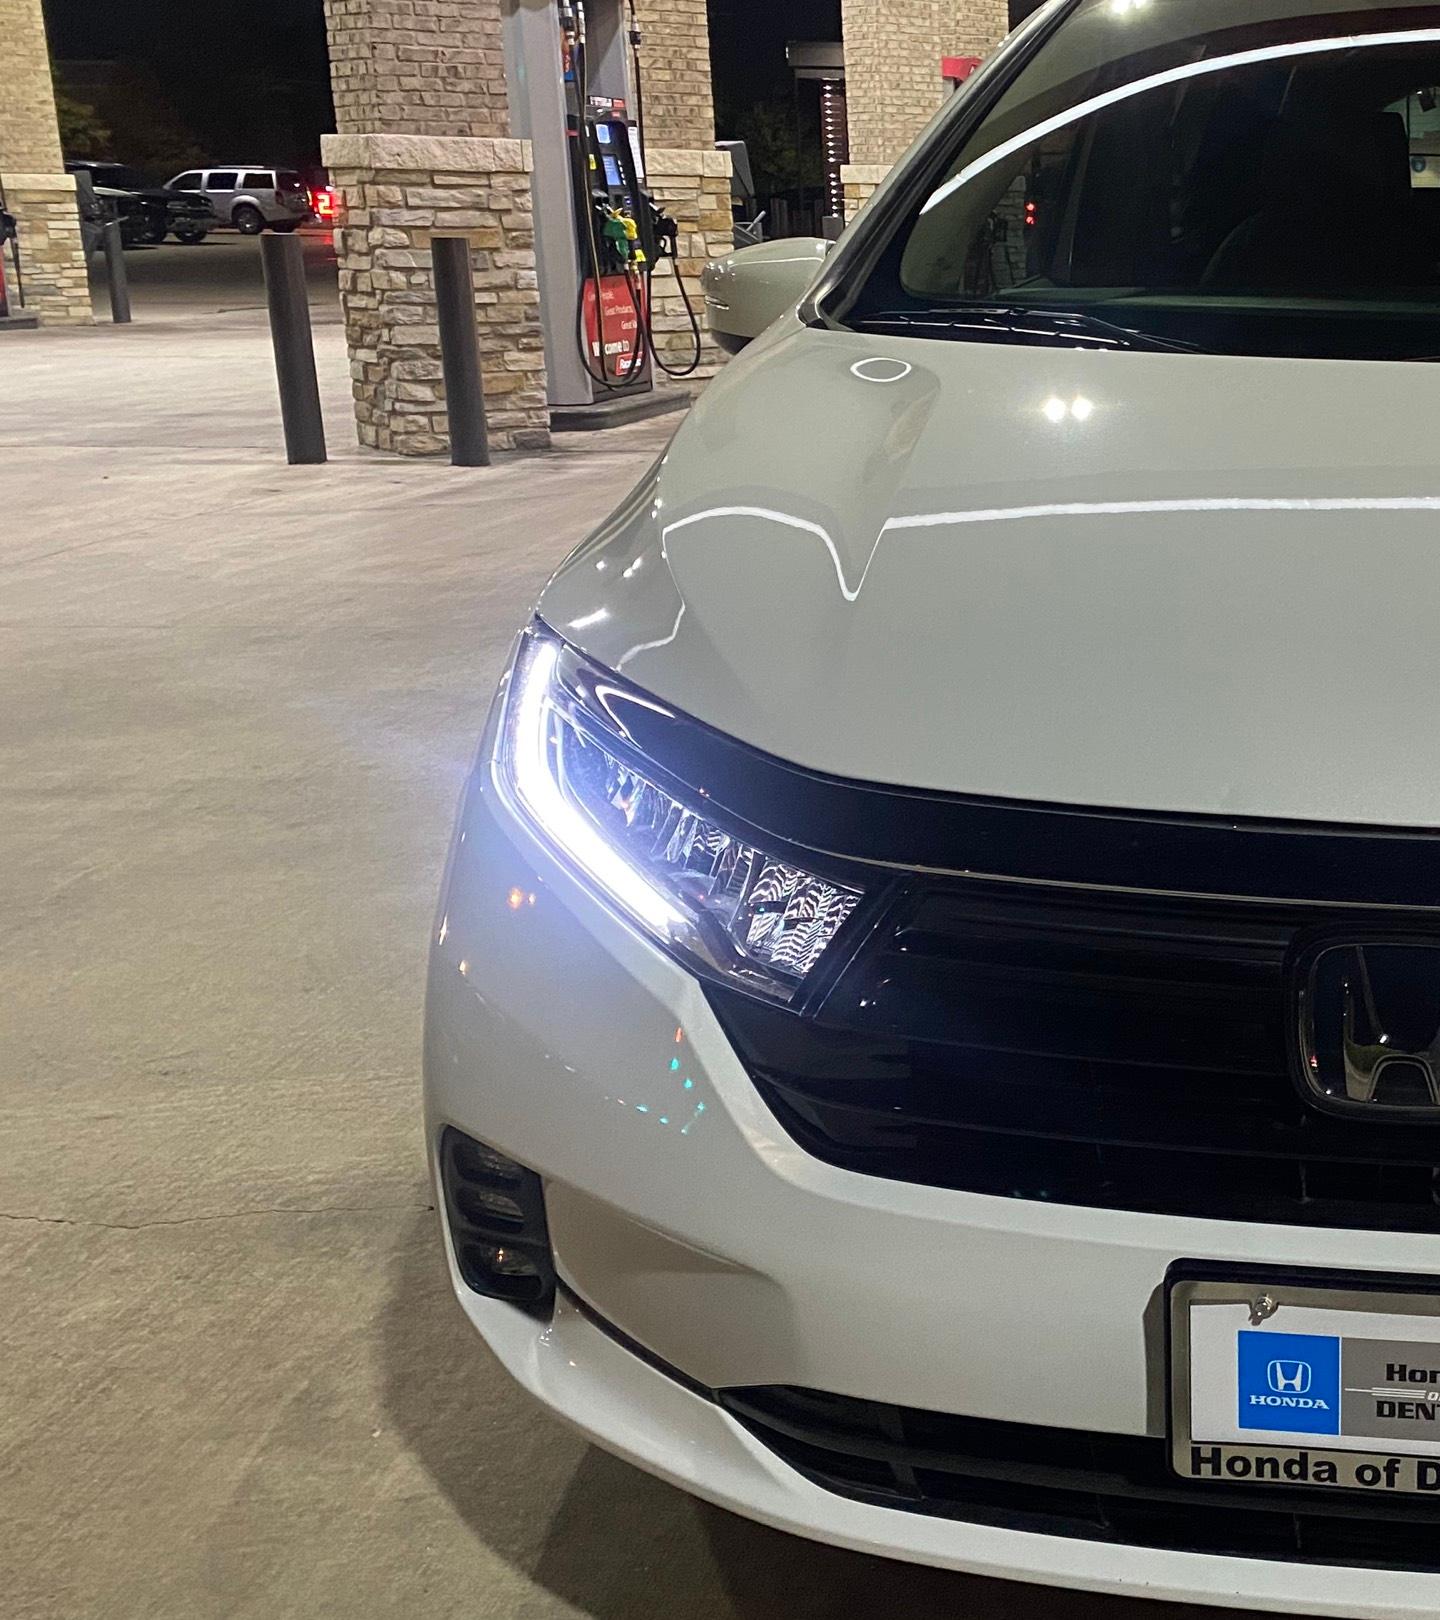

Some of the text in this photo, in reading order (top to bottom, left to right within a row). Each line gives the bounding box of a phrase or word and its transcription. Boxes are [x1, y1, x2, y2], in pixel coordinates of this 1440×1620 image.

[1249, 1394, 1330, 1410] HONDA
[1190, 1446, 1338, 1484] Honda
[1354, 1457, 1402, 1489] of
